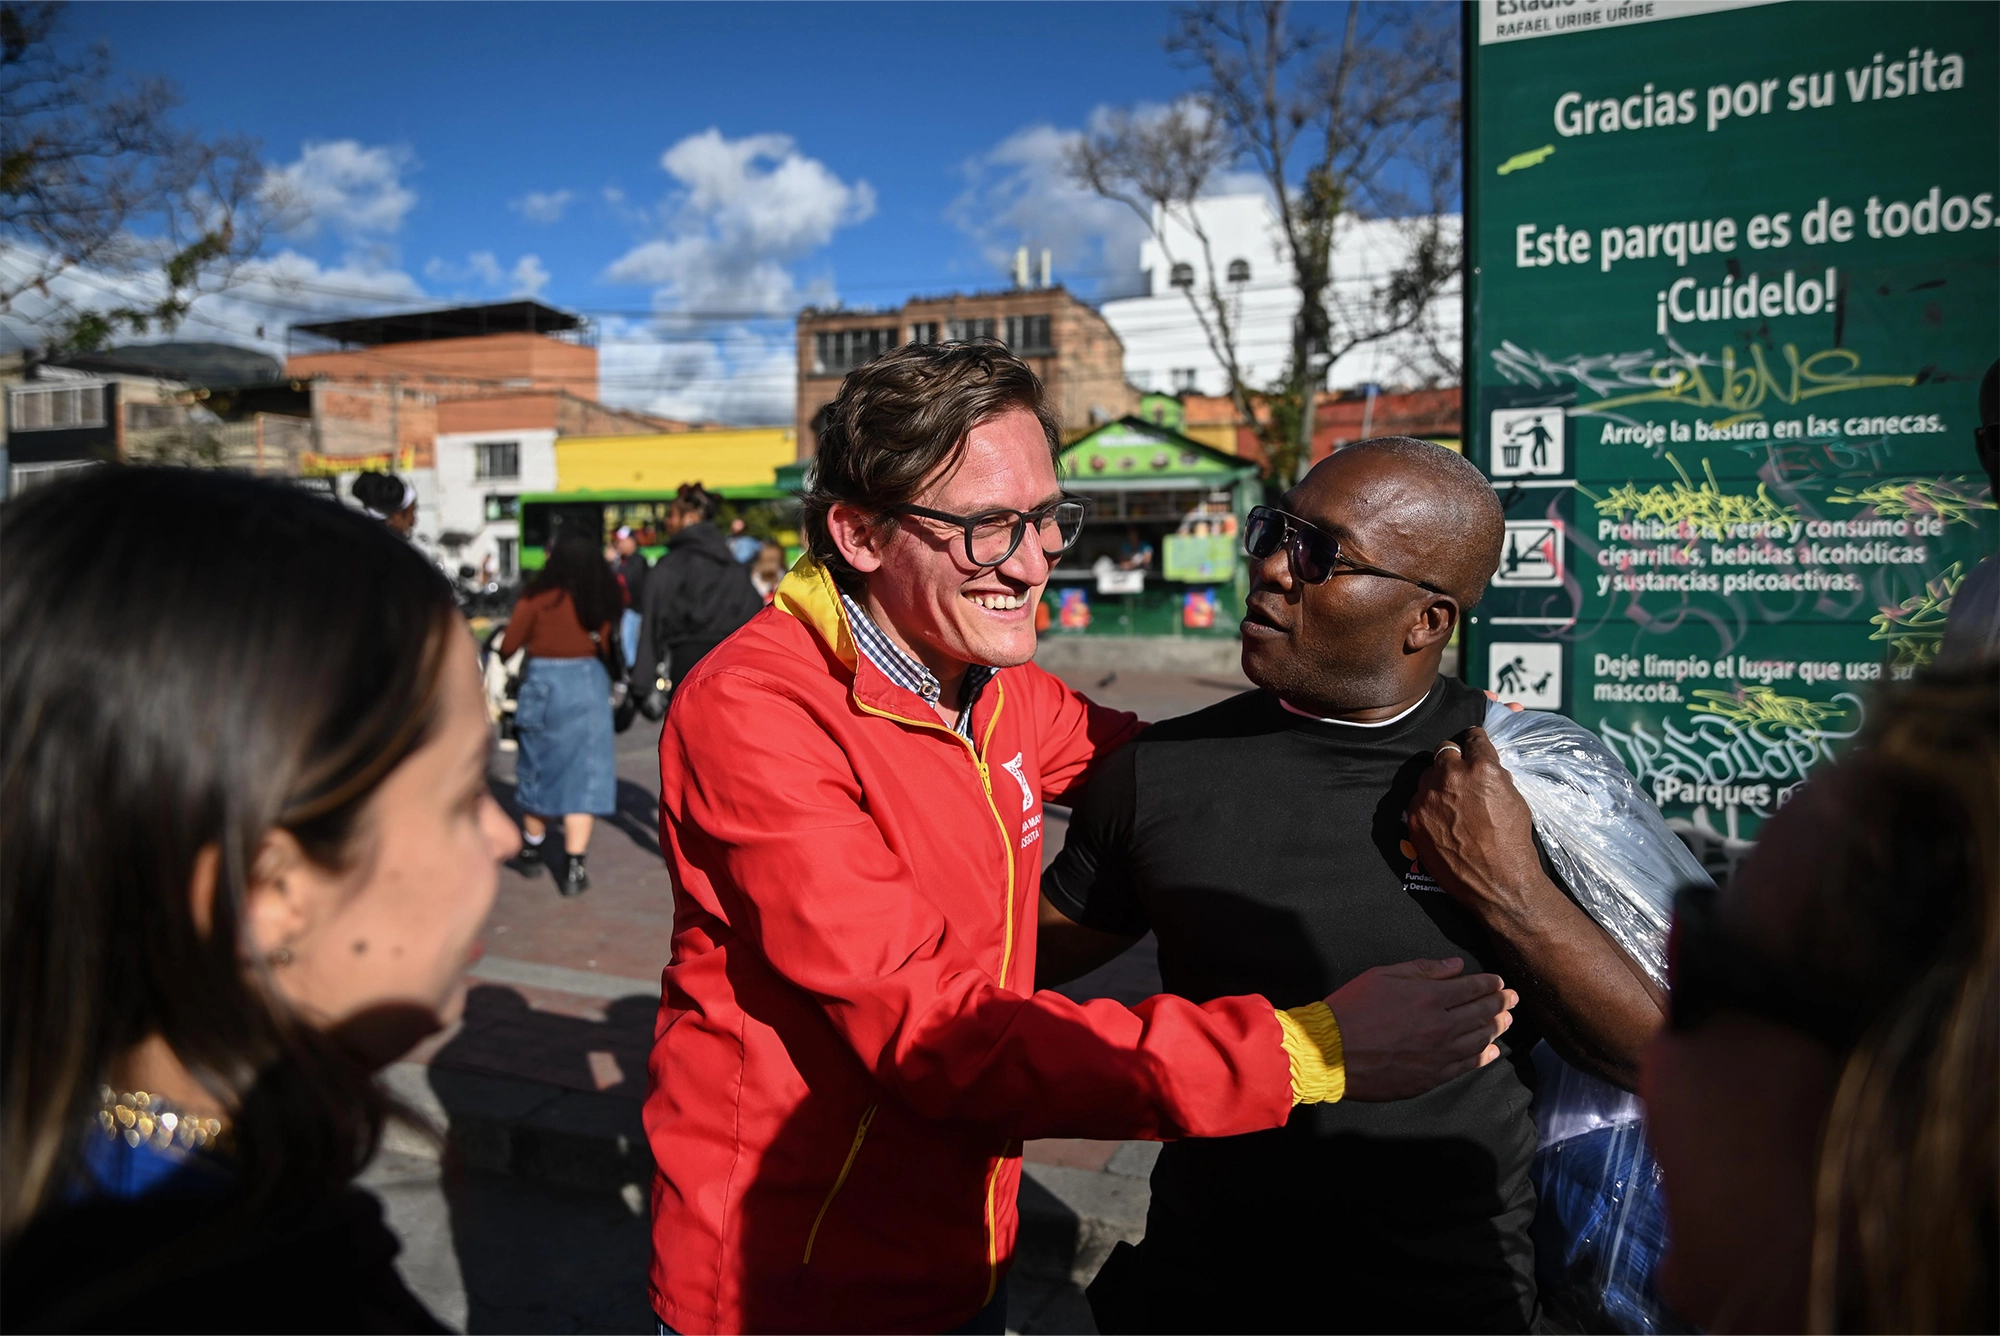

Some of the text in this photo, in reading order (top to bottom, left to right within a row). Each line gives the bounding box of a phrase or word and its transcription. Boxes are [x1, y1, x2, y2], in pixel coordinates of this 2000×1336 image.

[1496, 3, 1655, 38] RAFAEL URIBE URIBE
[1553, 47, 1965, 137] Gracias por su visita
[1515, 186, 2000, 273] Este parque es de todos.
[1656, 266, 1838, 336] ¡Cuídelo!
[1600, 412, 1947, 447] Arroje la basura en las canecas.
[1598, 517, 1697, 541] Prohibida
[1726, 519, 1785, 540] venta
[1787, 519, 1803, 544] y
[1805, 517, 1908, 539] consumo
[1914, 511, 1944, 537] de
[1597, 540, 1927, 571] cigarrillos, bebidas alcohólicas
[1597, 567, 1863, 597] y sustancias psicoactivas.
[1594, 653, 1640, 681] Deje
[1644, 654, 1711, 681] limpio
[1714, 654, 1735, 678] el
[1738, 654, 1796, 684] lugar
[1798, 659, 1842, 685] que
[1845, 659, 1882, 681] usa
[1594, 682, 1685, 704] mascota.
[1655, 776, 1771, 811] ¡Parques
[1021, 827, 1039, 849] OGOTÁ
